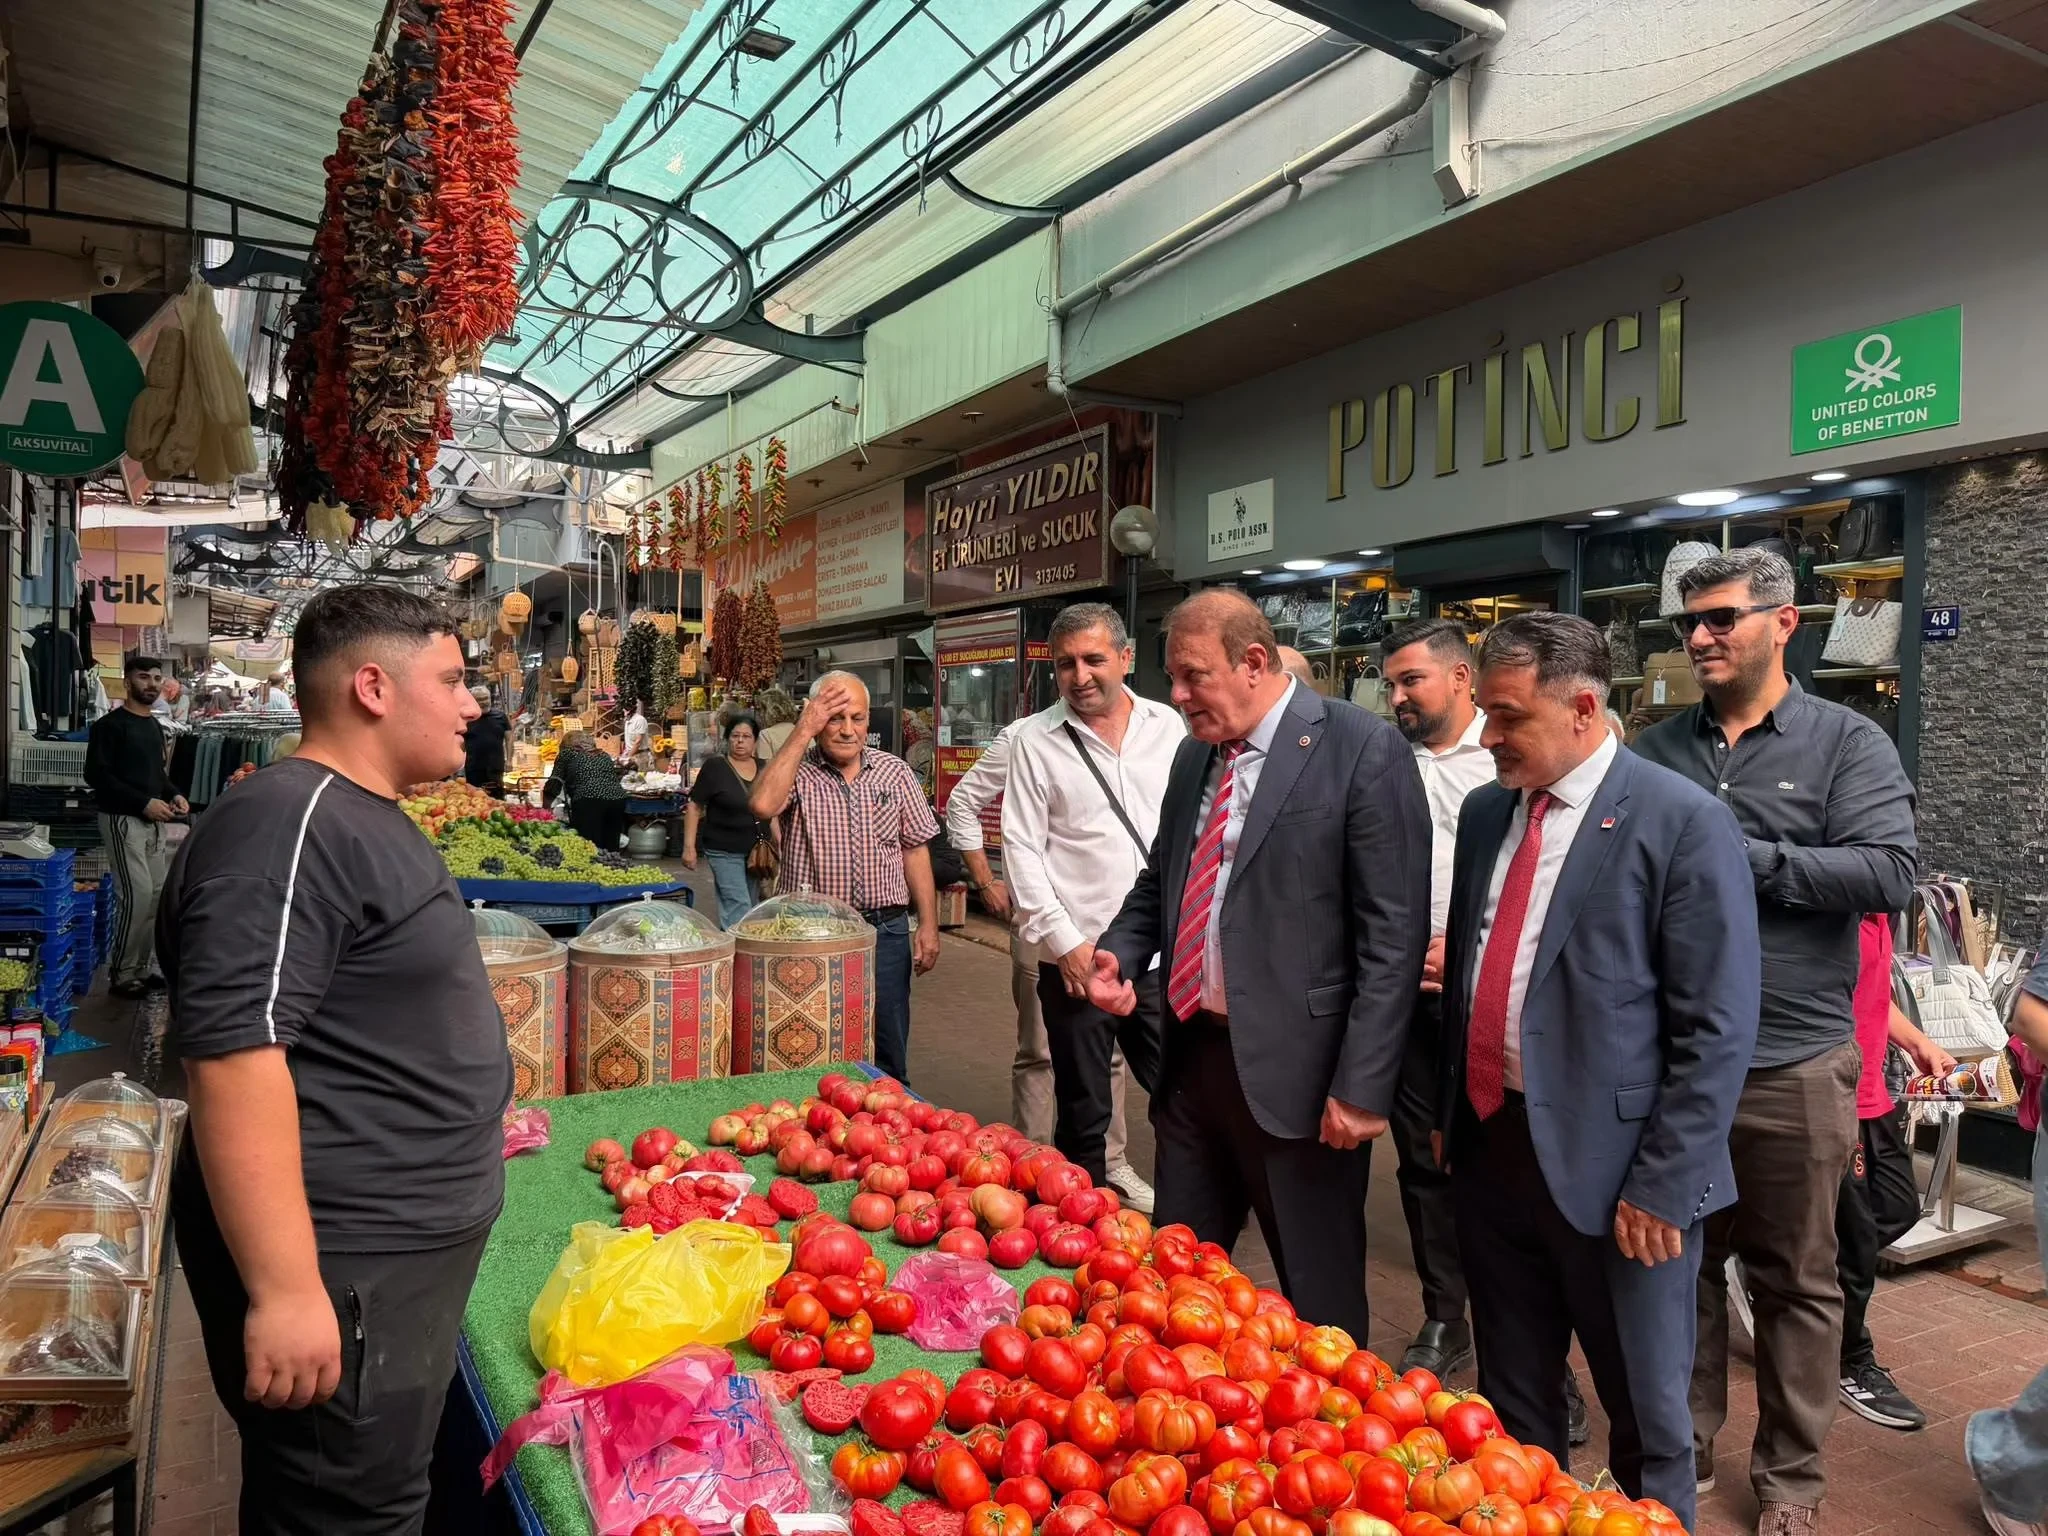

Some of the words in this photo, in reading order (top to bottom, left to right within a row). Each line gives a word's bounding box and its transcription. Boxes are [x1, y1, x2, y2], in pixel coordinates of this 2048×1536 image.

[0, 318, 106, 433] A
[1326, 273, 1690, 502] POTİNCİ
[1811, 398, 1868, 421] UNITED
[1873, 383, 1937, 409] COLORS
[1818, 425, 1838, 441] OF
[1842, 407, 1928, 437] BENETTON
[12, 437, 88, 453] AKSUVİTAL
[1007, 451, 1099, 515] YILDIR
[932, 545, 948, 573] ET
[951, 523, 1017, 569] ÜRÜNLERİ
[1021, 534, 1036, 552] ve
[1041, 509, 1097, 549] SUCUK
[1210, 532, 1225, 545] U.S.
[1227, 526, 1246, 541] POLO
[840, 546, 860, 560] SARMA
[840, 561, 869, 576] TARHANA
[995, 558, 1022, 593] EVİ
[836, 596, 863, 610] BAKLAVA
[1931, 611, 1950, 626] 48
